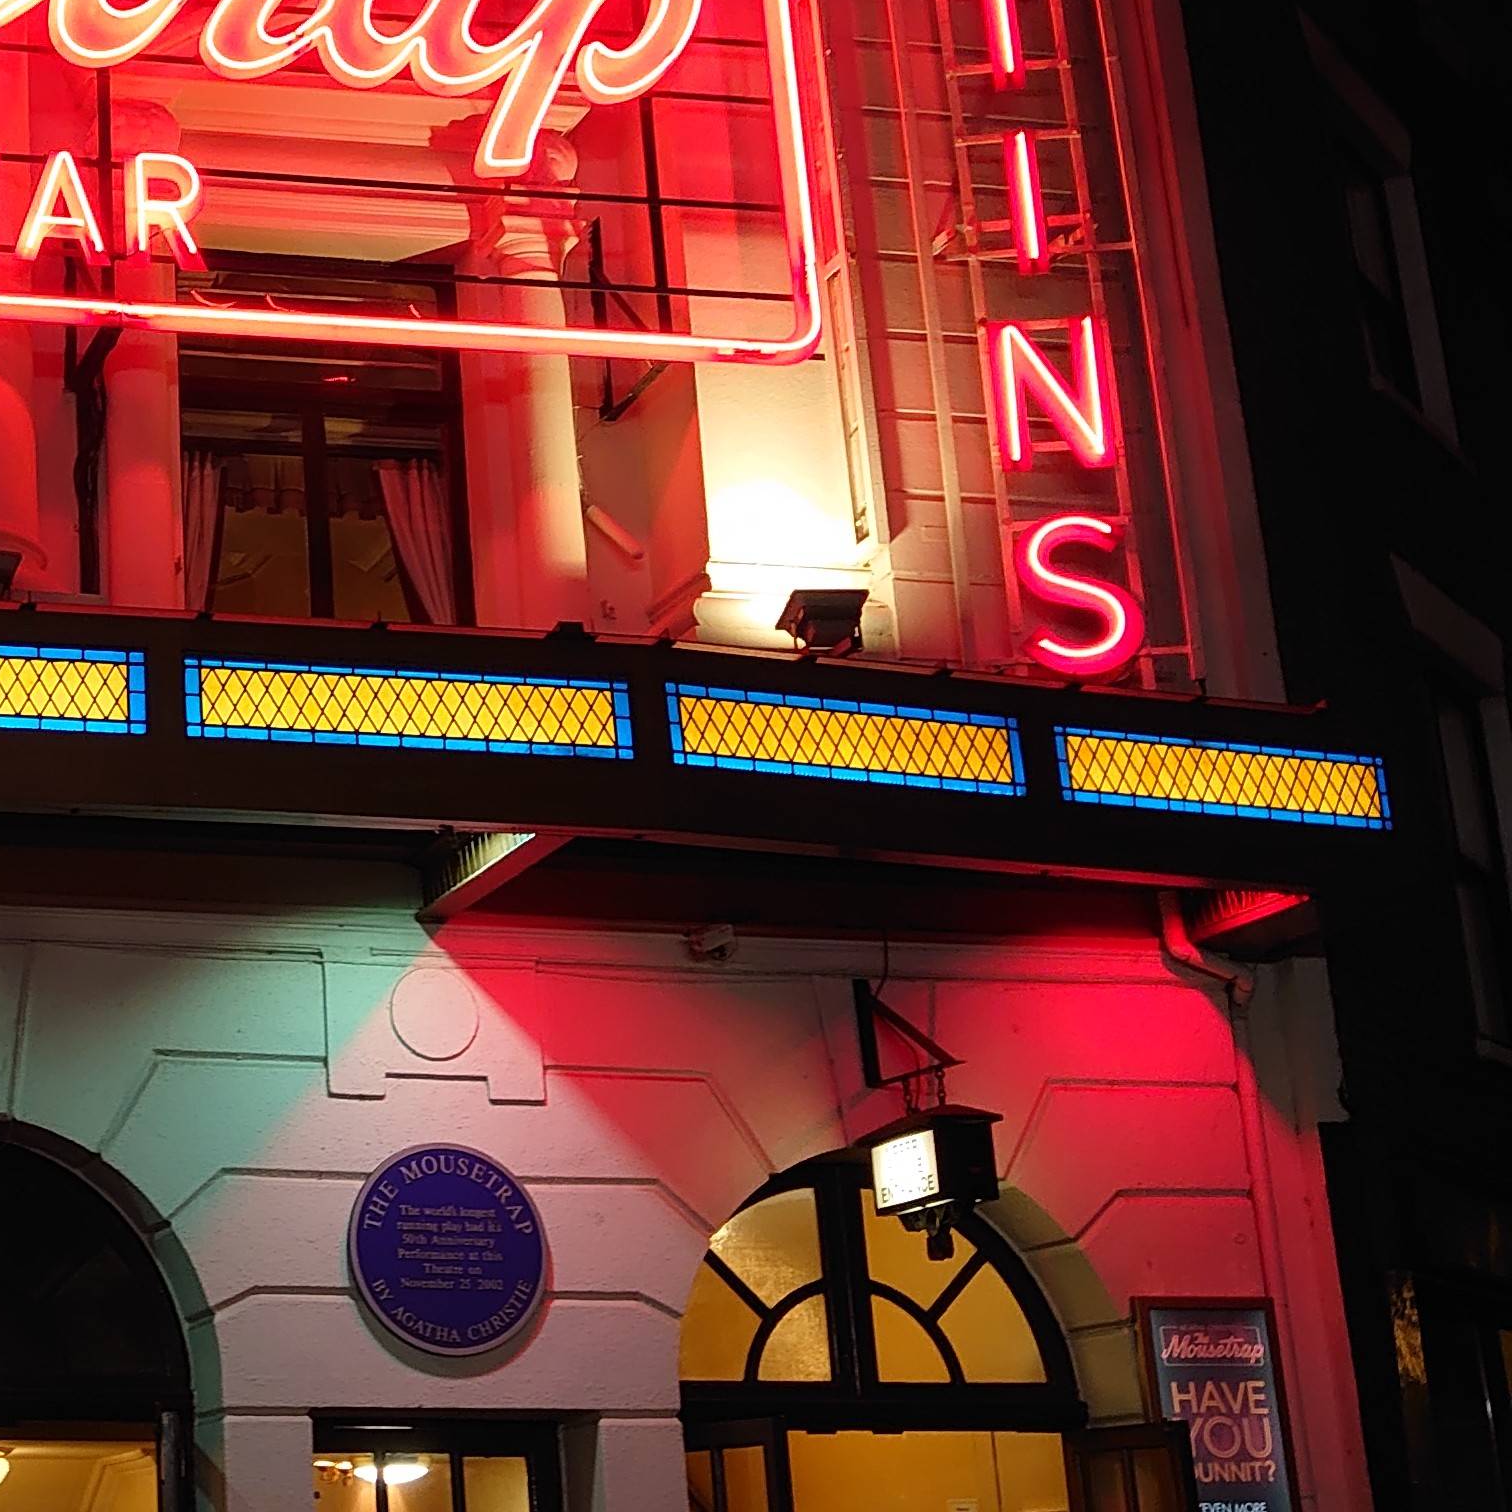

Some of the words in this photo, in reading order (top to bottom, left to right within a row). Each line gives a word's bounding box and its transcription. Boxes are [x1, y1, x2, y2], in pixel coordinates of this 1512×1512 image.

[363, 1180, 400, 1230] THE
[400, 1155, 534, 1235] MOUSETRAP
[399, 1204, 421, 1216] The
[397, 1248, 465, 1260] Performance
[422, 1263, 464, 1274] Theatre
[371, 1278, 394, 1302] BY
[391, 1306, 462, 1343] AGATHA
[467, 1279, 534, 1340] CHRISTIE
[1161, 1334, 1265, 1364] Mousetrap
[1170, 1380, 1269, 1415] HAVE
[1194, 1460, 1276, 1483] UNNIT?
